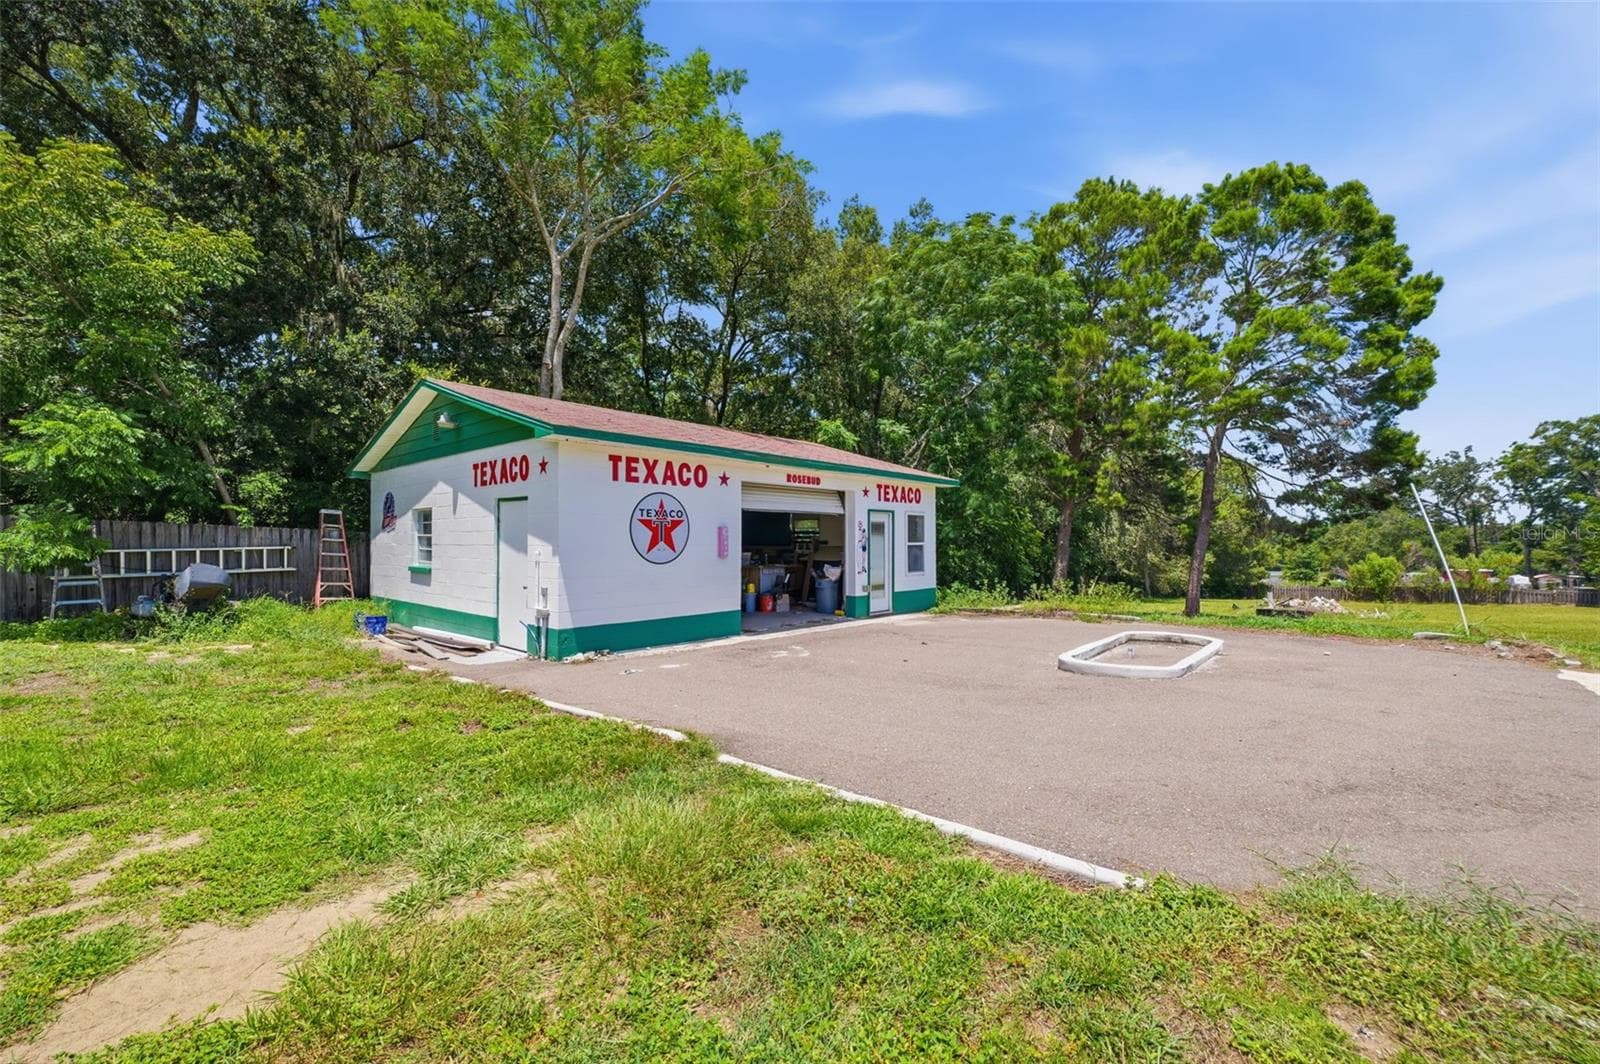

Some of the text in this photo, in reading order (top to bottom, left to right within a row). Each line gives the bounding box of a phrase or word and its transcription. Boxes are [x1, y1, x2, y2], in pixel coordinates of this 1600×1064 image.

[472, 454, 530, 488] TEXACO
[608, 454, 708, 488] TEXACO
[786, 473, 821, 486] ROSEBUD
[876, 483, 922, 504] TEXACO
[639, 508, 684, 518] TEXACO
